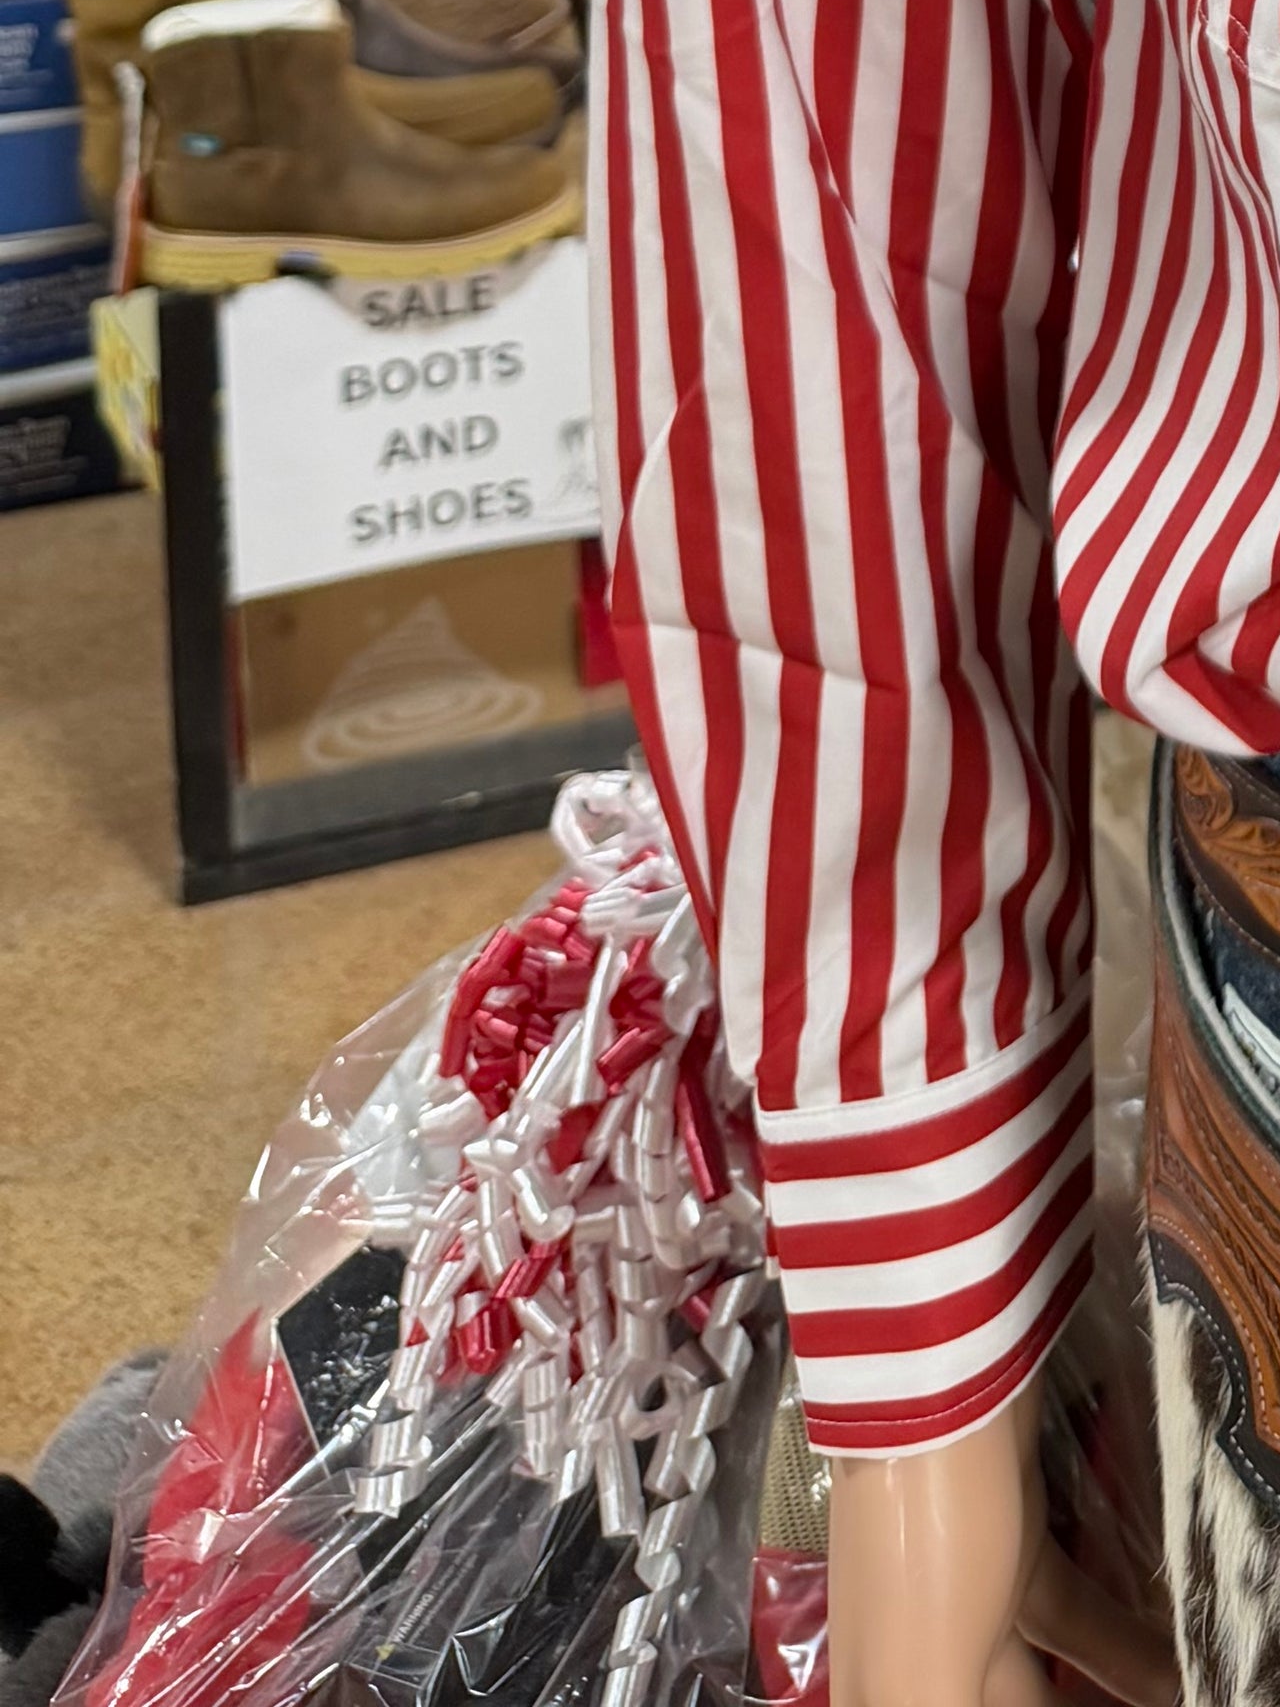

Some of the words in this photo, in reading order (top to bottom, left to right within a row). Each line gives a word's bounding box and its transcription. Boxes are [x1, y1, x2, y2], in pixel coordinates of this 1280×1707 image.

[363, 274, 494, 328] SALE
[341, 341, 522, 405] BOOTS
[379, 415, 498, 468] AND
[351, 479, 531, 542] SHOES
[391, 1593, 434, 1644] WARNING
